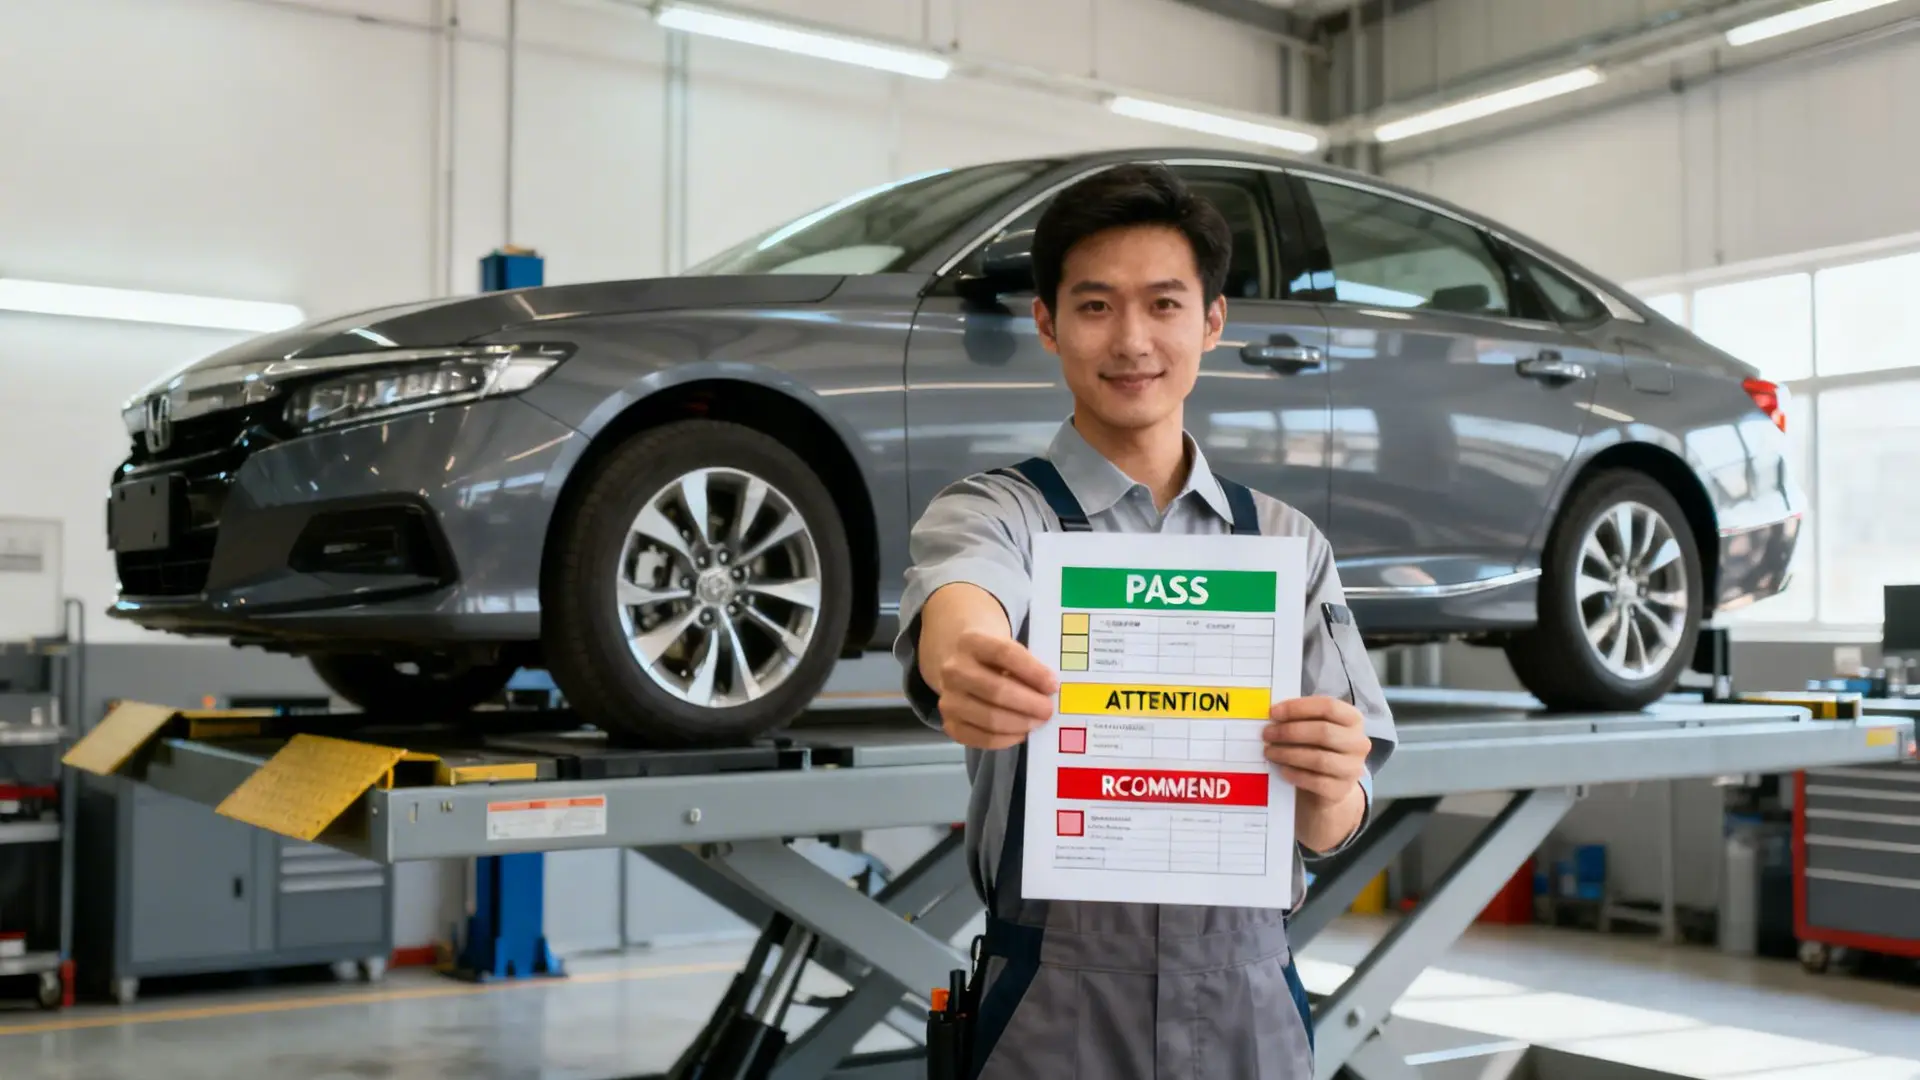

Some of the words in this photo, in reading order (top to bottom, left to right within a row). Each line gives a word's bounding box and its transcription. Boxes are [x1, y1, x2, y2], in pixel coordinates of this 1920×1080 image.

[1126, 574, 1209, 605] PASS
[1105, 690, 1230, 712] ATTENTION
[1101, 774, 1231, 799] RCOMMEND
